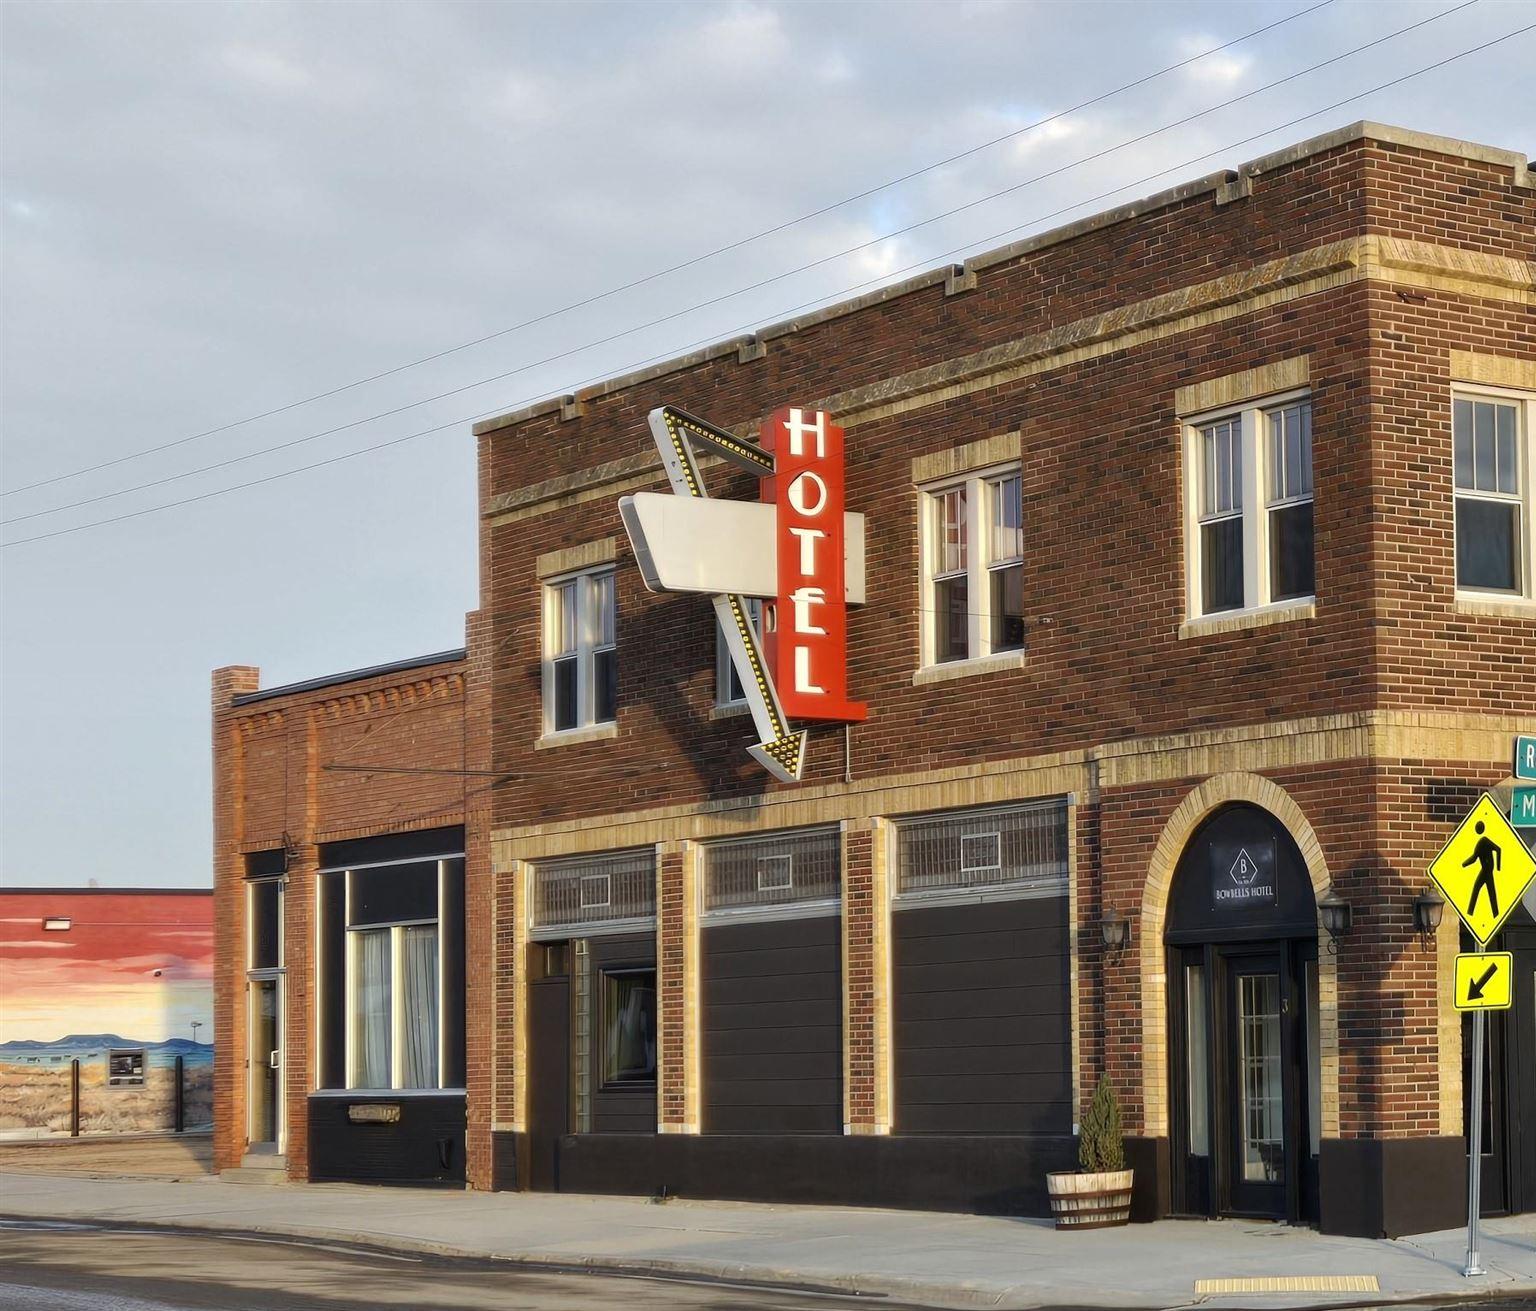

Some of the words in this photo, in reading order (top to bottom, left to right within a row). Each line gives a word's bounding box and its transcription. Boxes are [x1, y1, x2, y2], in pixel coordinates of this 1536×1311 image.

[783, 408, 828, 694] HOTEL
[1240, 858, 1248, 874] B
[1251, 885, 1274, 897] HOTEL
